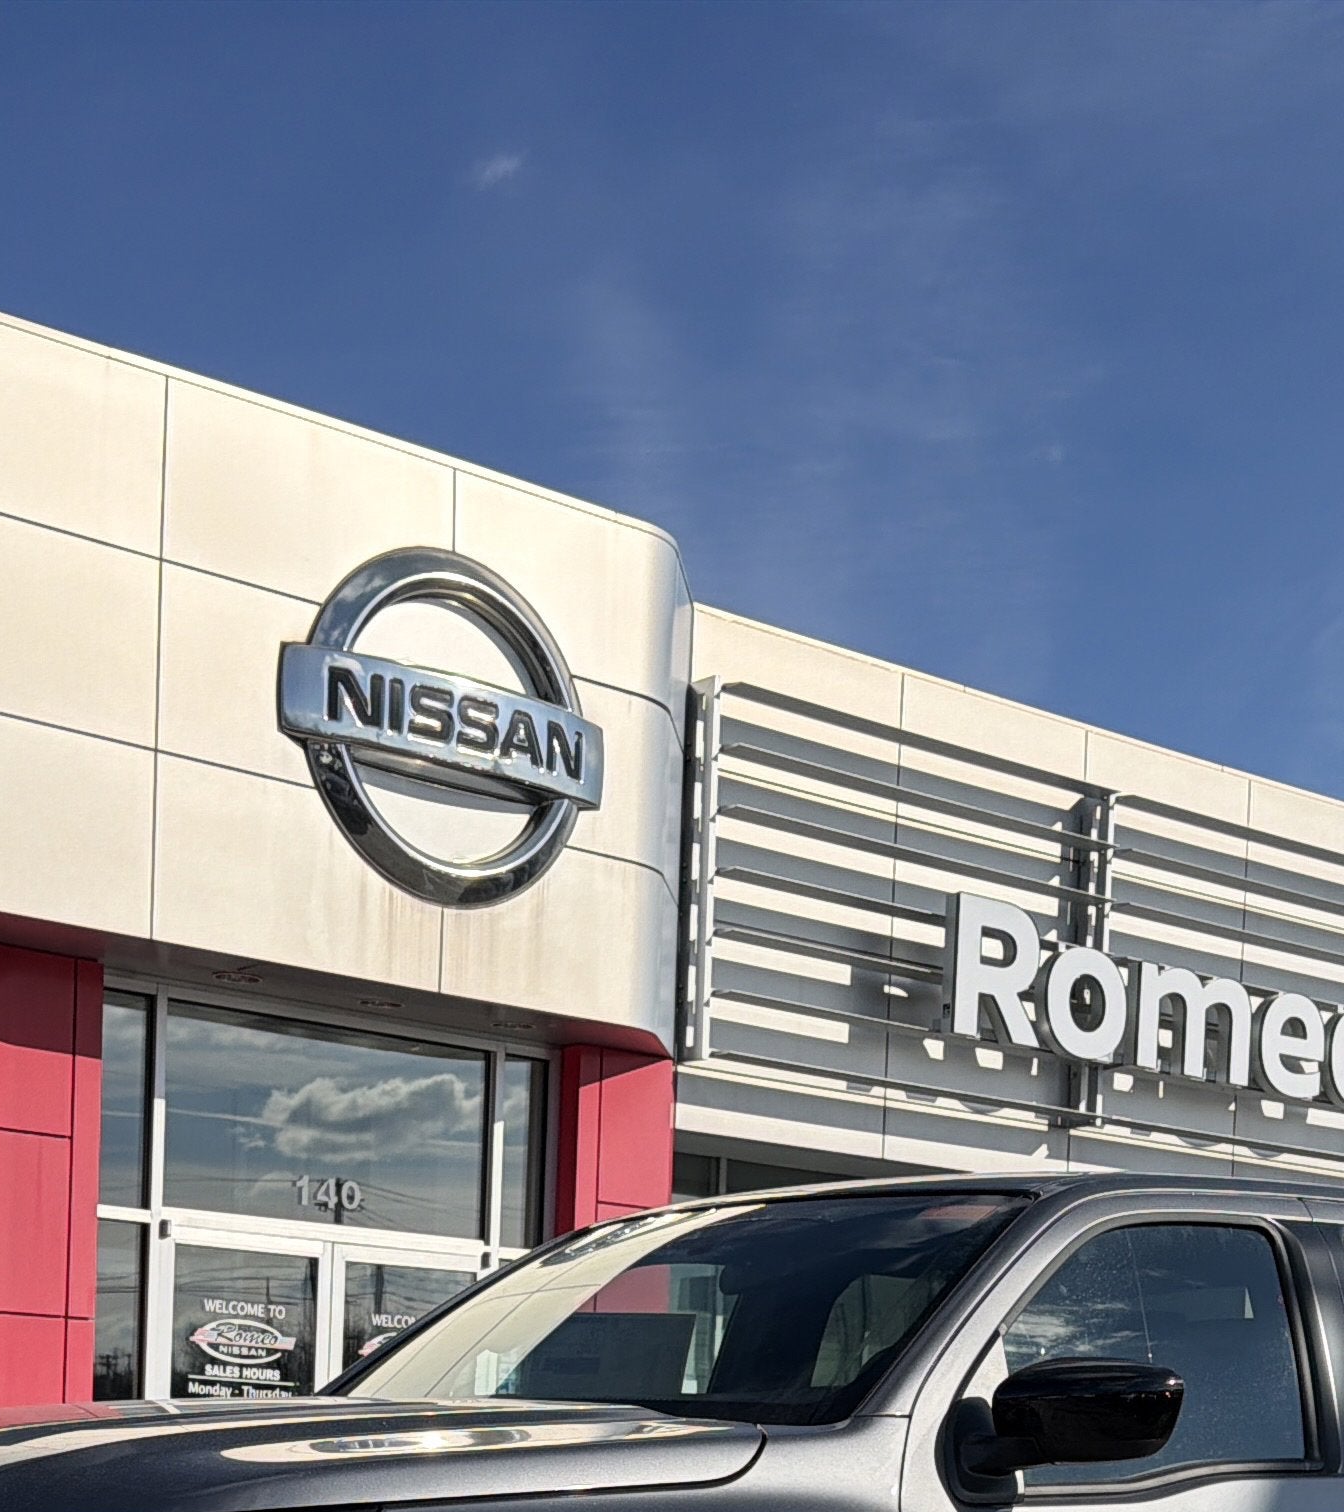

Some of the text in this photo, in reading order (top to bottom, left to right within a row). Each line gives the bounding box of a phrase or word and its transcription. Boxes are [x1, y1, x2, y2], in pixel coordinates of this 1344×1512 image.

[323, 664, 585, 783] NISSAN
[295, 1174, 362, 1211] 140
[203, 1298, 286, 1319] WELCOME TO
[214, 1321, 279, 1346] Romeo
[218, 1345, 267, 1357] NISSAN
[204, 1363, 281, 1381] SALES HOURS
[188, 1381, 233, 1399] Monday
